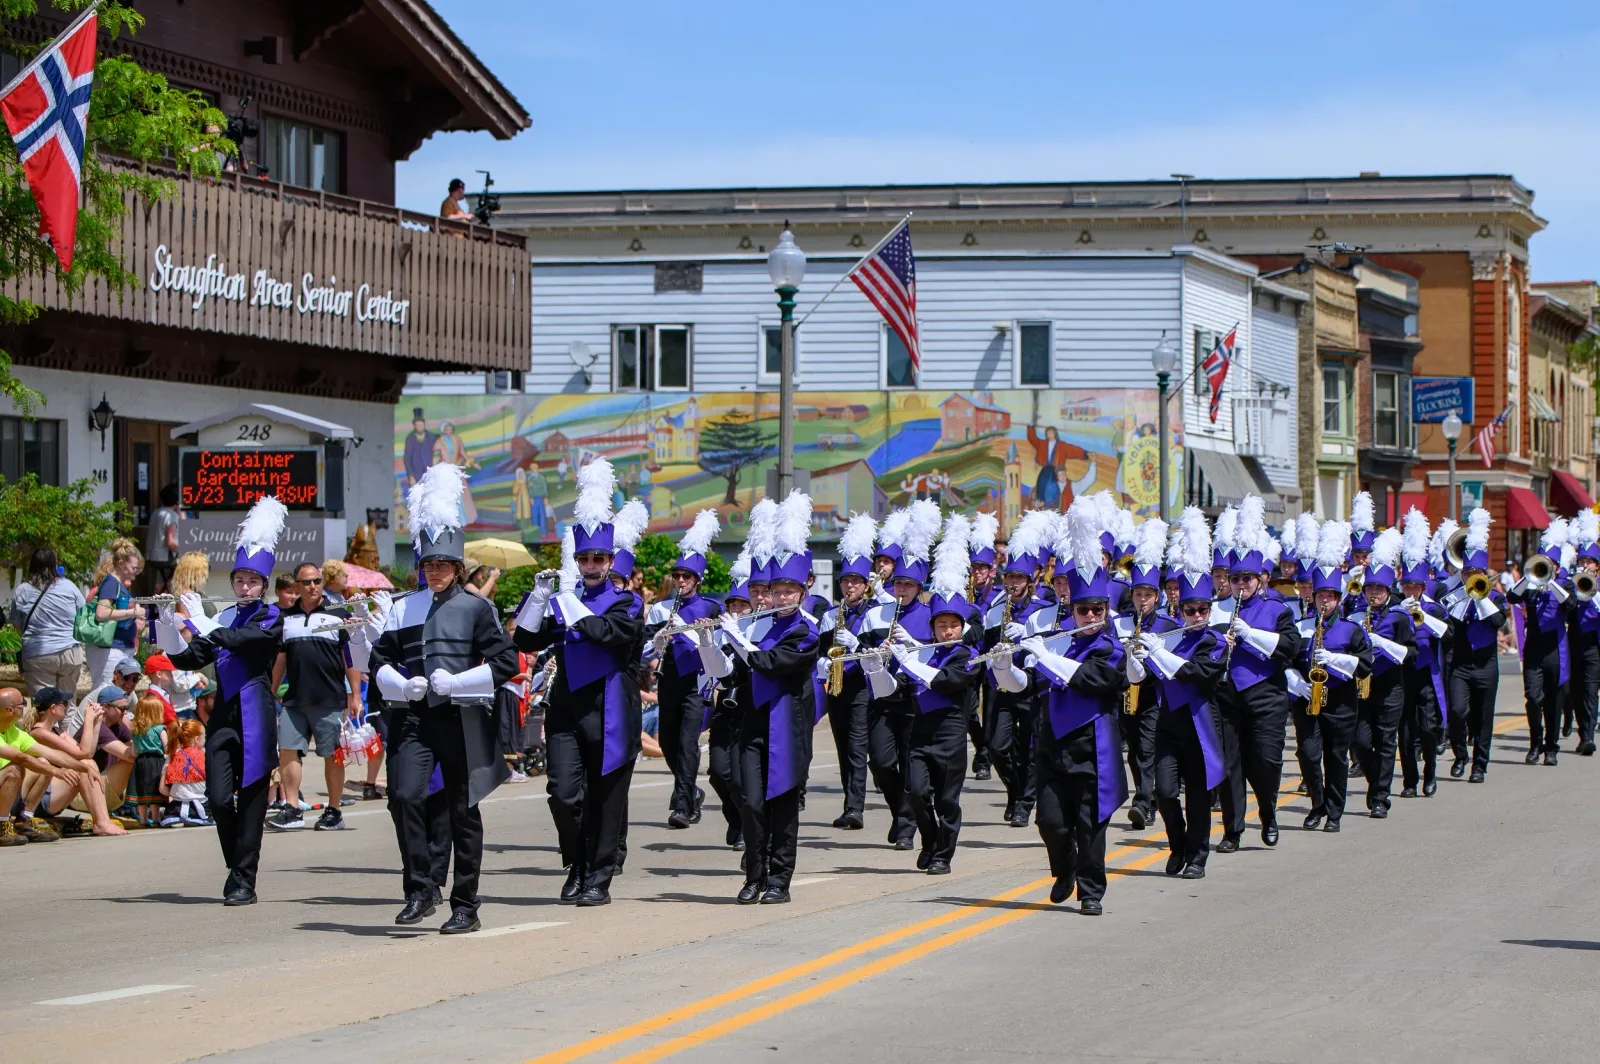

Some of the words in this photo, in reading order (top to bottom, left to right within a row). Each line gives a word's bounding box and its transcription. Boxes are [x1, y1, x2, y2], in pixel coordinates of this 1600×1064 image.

[150, 244, 247, 310] Stoughton
[250, 269, 293, 309] Area
[297, 272, 353, 316] Senior
[357, 283, 409, 325] Center
[236, 424, 272, 441] 248
[200, 450, 295, 468] Container
[196, 468, 291, 486] Gardening
[182, 486, 225, 504] 5/23
[275, 485, 319, 504] RSVP
[280, 526, 318, 543] Area
